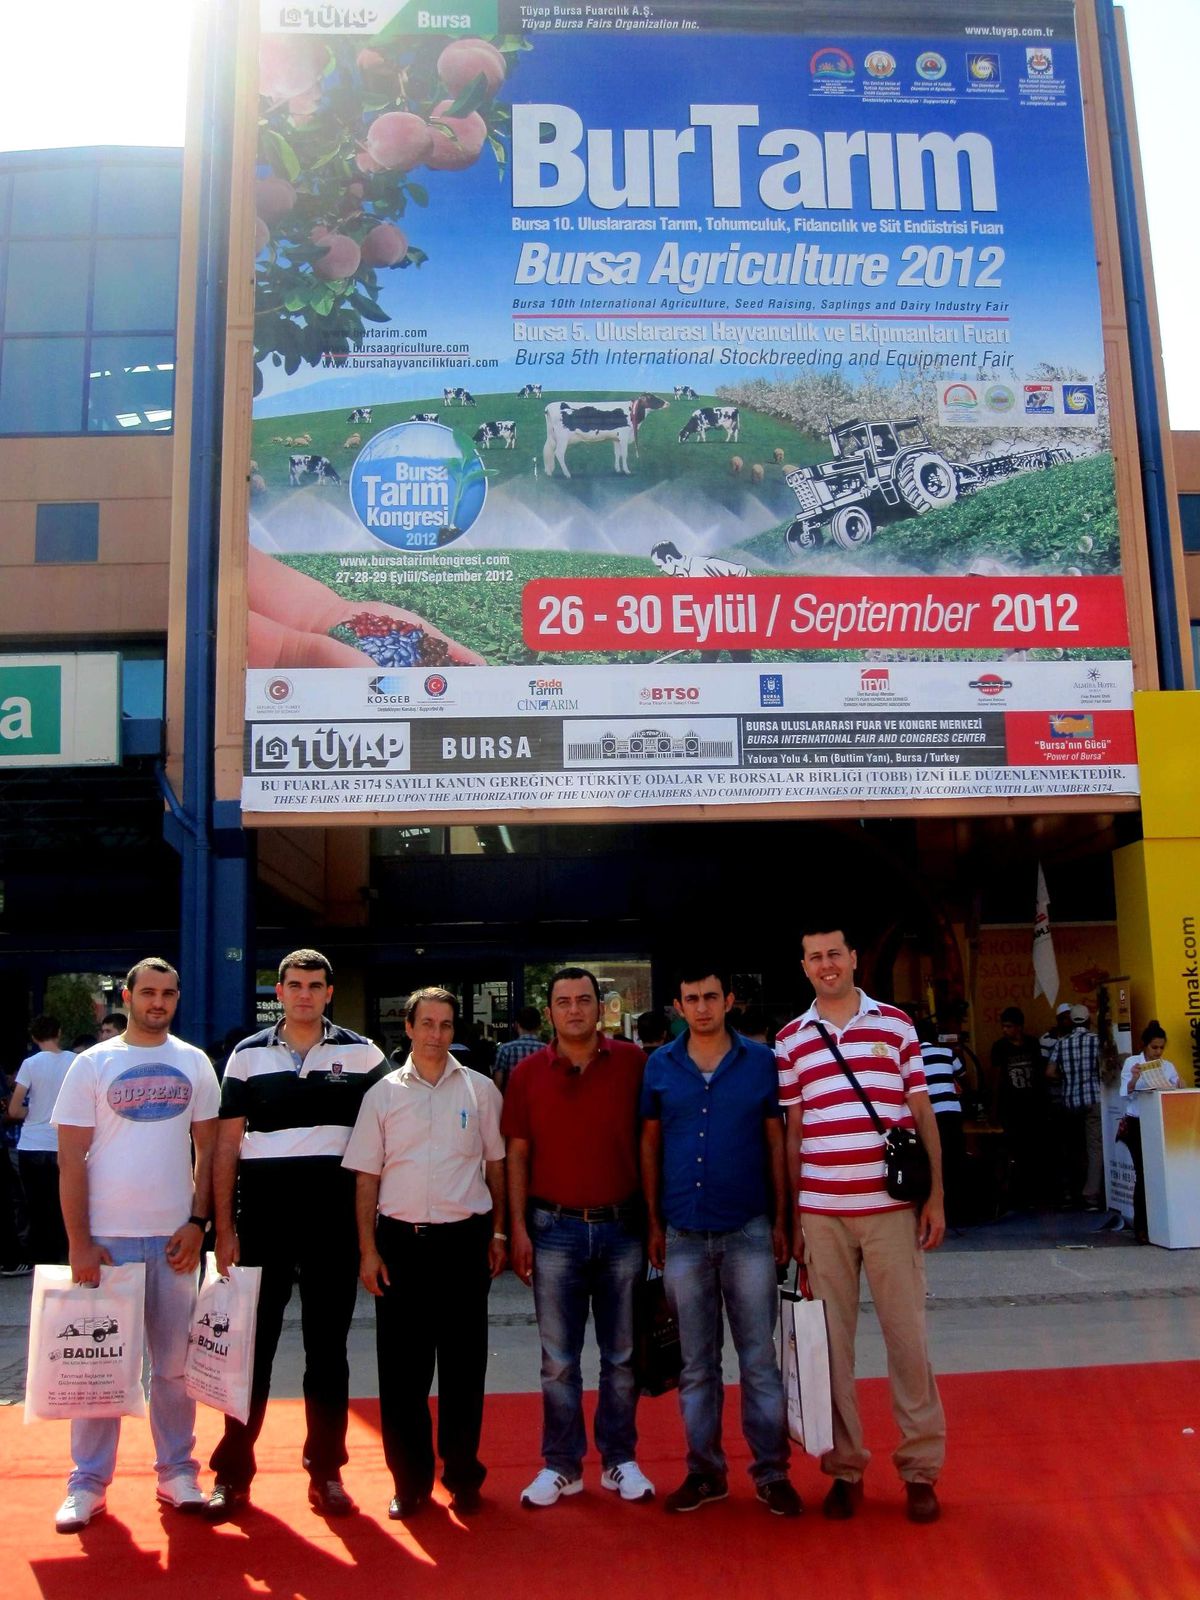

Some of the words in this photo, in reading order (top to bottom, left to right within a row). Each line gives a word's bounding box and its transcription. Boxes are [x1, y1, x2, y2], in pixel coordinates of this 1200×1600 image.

[520, 5, 550, 17] Tüyap
[554, 6, 582, 15] Bursa
[586, 6, 629, 15] Fuarcılık
[632, 6, 653, 18] A.Ş.
[418, 11, 471, 28] Bursa
[521, 19, 551, 30] Tüyap
[555, 19, 583, 29] Bursa
[587, 19, 612, 29] Fairs
[615, 19, 679, 30] Organization
[682, 20, 700, 29] Inc.
[965, 25, 1054, 37] www.tuyap.com.tr
[512, 103, 998, 211] BurTarım
[512, 217, 549, 231] Bursa
[553, 217, 574, 231] 10.
[578, 217, 656, 231] Uluslararası
[660, 217, 702, 233] Tarım,
[705, 217, 790, 234] Tohumculuk,
[794, 218, 858, 233] Fidancılık
[861, 222, 876, 233] ve
[879, 219, 901, 233] Süt
[904, 220, 968, 235] Endüstrisi
[971, 221, 1004, 235] Fuarı
[513, 242, 641, 285] Bursa
[647, 242, 890, 295] Agriculture
[896, 245, 1006, 288] 2012
[512, 299, 545, 309] Bursa
[551, 299, 575, 309] 10th
[580, 299, 657, 309] International
[660, 299, 730, 311] Agriculture,
[735, 299, 763, 309] Seed
[768, 299, 816, 311] Raising,
[821, 300, 871, 312] Saplings
[876, 300, 896, 310] and
[900, 301, 931, 312] Dairy
[935, 301, 981, 313] Industry
[985, 302, 1009, 311] Fair
[322, 328, 427, 338] burtarim.com
[513, 321, 569, 341] Bursa
[571, 322, 590, 341] 5.
[595, 321, 706, 341] Uluslararası
[711, 322, 819, 345] Hayvancılık
[824, 327, 845, 342] ve
[850, 323, 959, 346] Ekipmanları
[963, 325, 1009, 343] Fuarı
[322, 342, 469, 355] .bursaagriculture.com
[322, 357, 499, 370] www.bursahayvancilikfuari.com
[515, 349, 564, 365] Bursa
[570, 349, 599, 365] 5th
[606, 349, 714, 365] International
[719, 349, 843, 369] Stockbreeding
[849, 350, 879, 366] and
[886, 350, 977, 370] Equipment
[982, 351, 1014, 367] Fair
[396, 462, 448, 481] Bursa
[362, 475, 449, 506] Tarım
[367, 506, 449, 530] Kongresi
[406, 533, 437, 546] 2012
[340, 554, 510, 568] www.bursatarimkongresi.com
[336, 572, 387, 583] 27-28-29
[390, 570, 482, 584] Eylül/September
[486, 570, 513, 582] 2012
[538, 596, 584, 635] 26
[617, 596, 662, 634] 30
[672, 594, 756, 642] Eylül
[766, 596, 780, 637] /
[790, 593, 979, 641] September
[992, 593, 1079, 632] 2012
[367, 696, 410, 704] KOSGEB
[652, 687, 700, 700] BTSO
[0, 696, 33, 740] a
[746, 720, 779, 731] BURSA
[781, 720, 854, 731] ULUSLARARASI
[856, 720, 882, 731] FUAR
[884, 720, 897, 730] VE
[899, 720, 938, 730] KONGRE
[940, 717, 982, 730] MERKEZİ
[747, 734, 779, 745] BURSA
[781, 733, 853, 745] INTERNATIONAL
[855, 733, 877, 744] FAIR
[878, 733, 898, 744] AND
[899, 733, 950, 744] CONGRESS
[951, 733, 986, 743] CENTER
[291, 727, 404, 769] TÜYAP
[442, 736, 532, 759] BURSA
[747, 754, 778, 764] Yalova
[779, 754, 801, 764] Yolu
[803, 754, 812, 764] 4.
[814, 754, 829, 763] km
[830, 753, 864, 765] (Buttim
[866, 753, 893, 765] Yanı),
[895, 753, 922, 763] Bursa
[930, 753, 960, 764] Turkey
[1071, 752, 1079, 761] of
[261, 780, 281, 791] BU
[284, 779, 350, 791] FUARLAR
[354, 778, 382, 790] 5174
[385, 778, 432, 789] SAYILI
[435, 777, 486, 789] KANUN
[489, 773, 573, 788] GEREĞİNCE
[579, 772, 642, 786] TÜRKİYE
[645, 773, 703, 785] ODALAR
[707, 773, 726, 785] VE
[729, 772, 804, 784] BORSALAR
[808, 768, 862, 783] BİRLİĞİ
[866, 768, 913, 783] (TOBB)
[916, 768, 945, 782] İZNİ
[949, 766, 971, 782] İLE
[975, 766, 1126, 782] DÜZENLENMEKTEDİR.
[273, 795, 309, 805] THESE
[310, 795, 342, 805] FAIRS
[341, 794, 365, 804] ARE
[365, 794, 396, 804] HELD
[397, 793, 428, 803] UPON
[428, 793, 452, 803] THE
[452, 791, 538, 802] AUTHORIZATION
[540, 791, 553, 801] OF
[555, 790, 579, 800] THE
[580, 789, 616, 799] UNION
[616, 789, 632, 799] OF
[633, 789, 692, 799] CHAMBERS
[696, 788, 717, 798] AND
[717, 787, 784, 798] COMMODITY
[785, 786, 848, 796] EXCHANGES
[850, 786, 865, 796] OF
[866, 786, 909, 796] TURKEY,
[910, 786, 921, 795] IN
[923, 785, 993, 795] ACCORDANCE
[995, 784, 1022, 794] WITH
[1023, 784, 1047, 794] LAW
[1047, 784, 1091, 793] NUMBER
[1092, 783, 1115, 793] 5174.
[112, 1084, 190, 1105] SUPREME
[63, 1346, 123, 1359] BADILLI
